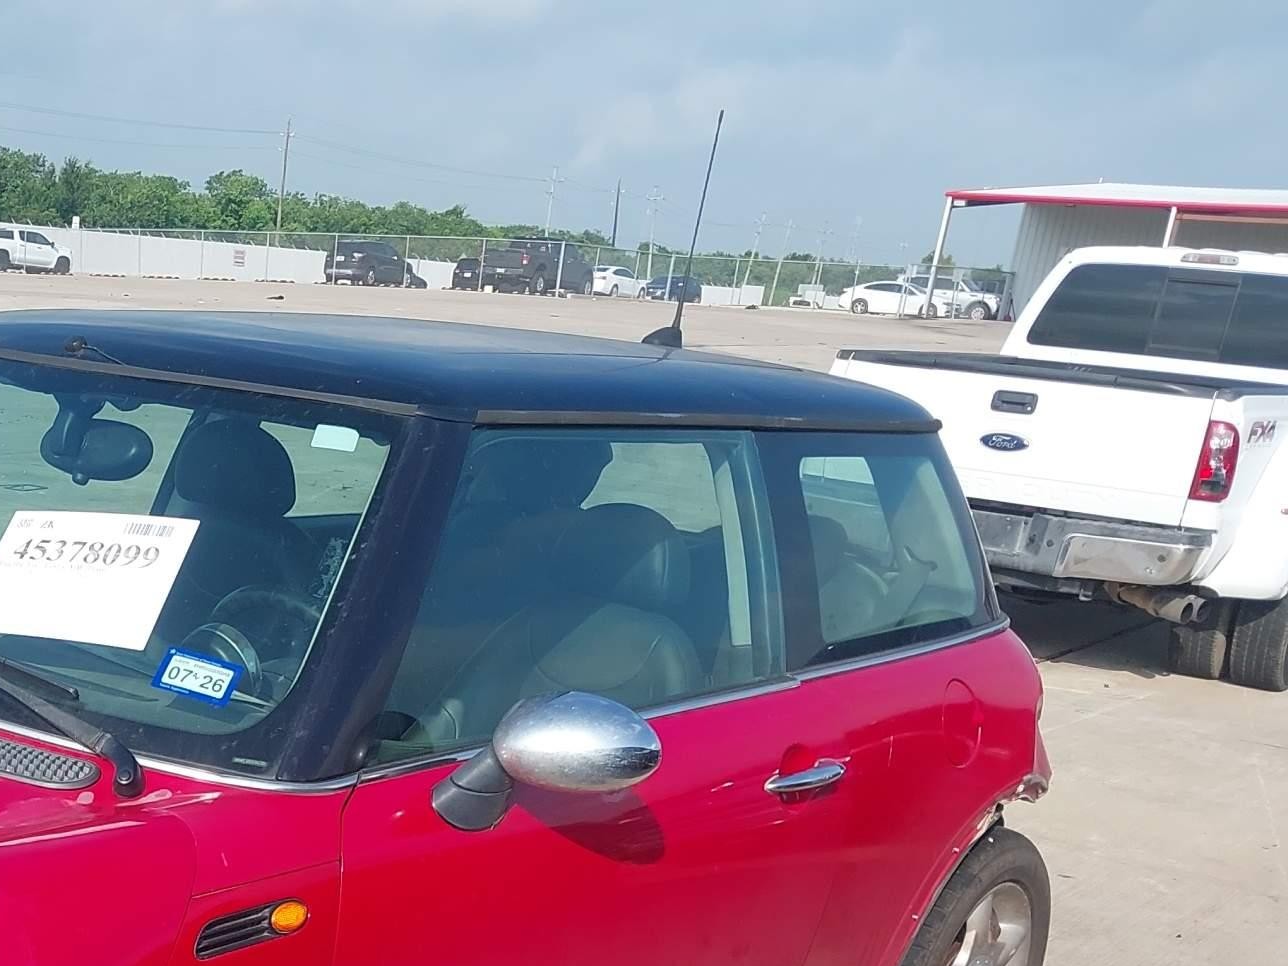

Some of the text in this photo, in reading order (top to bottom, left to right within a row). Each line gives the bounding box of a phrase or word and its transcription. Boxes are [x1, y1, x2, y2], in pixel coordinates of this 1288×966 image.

[1247, 420, 1277, 443] FX4
[14, 538, 160, 568] 45378099
[167, 665, 194, 684] 07
[199, 675, 226, 694] 26
